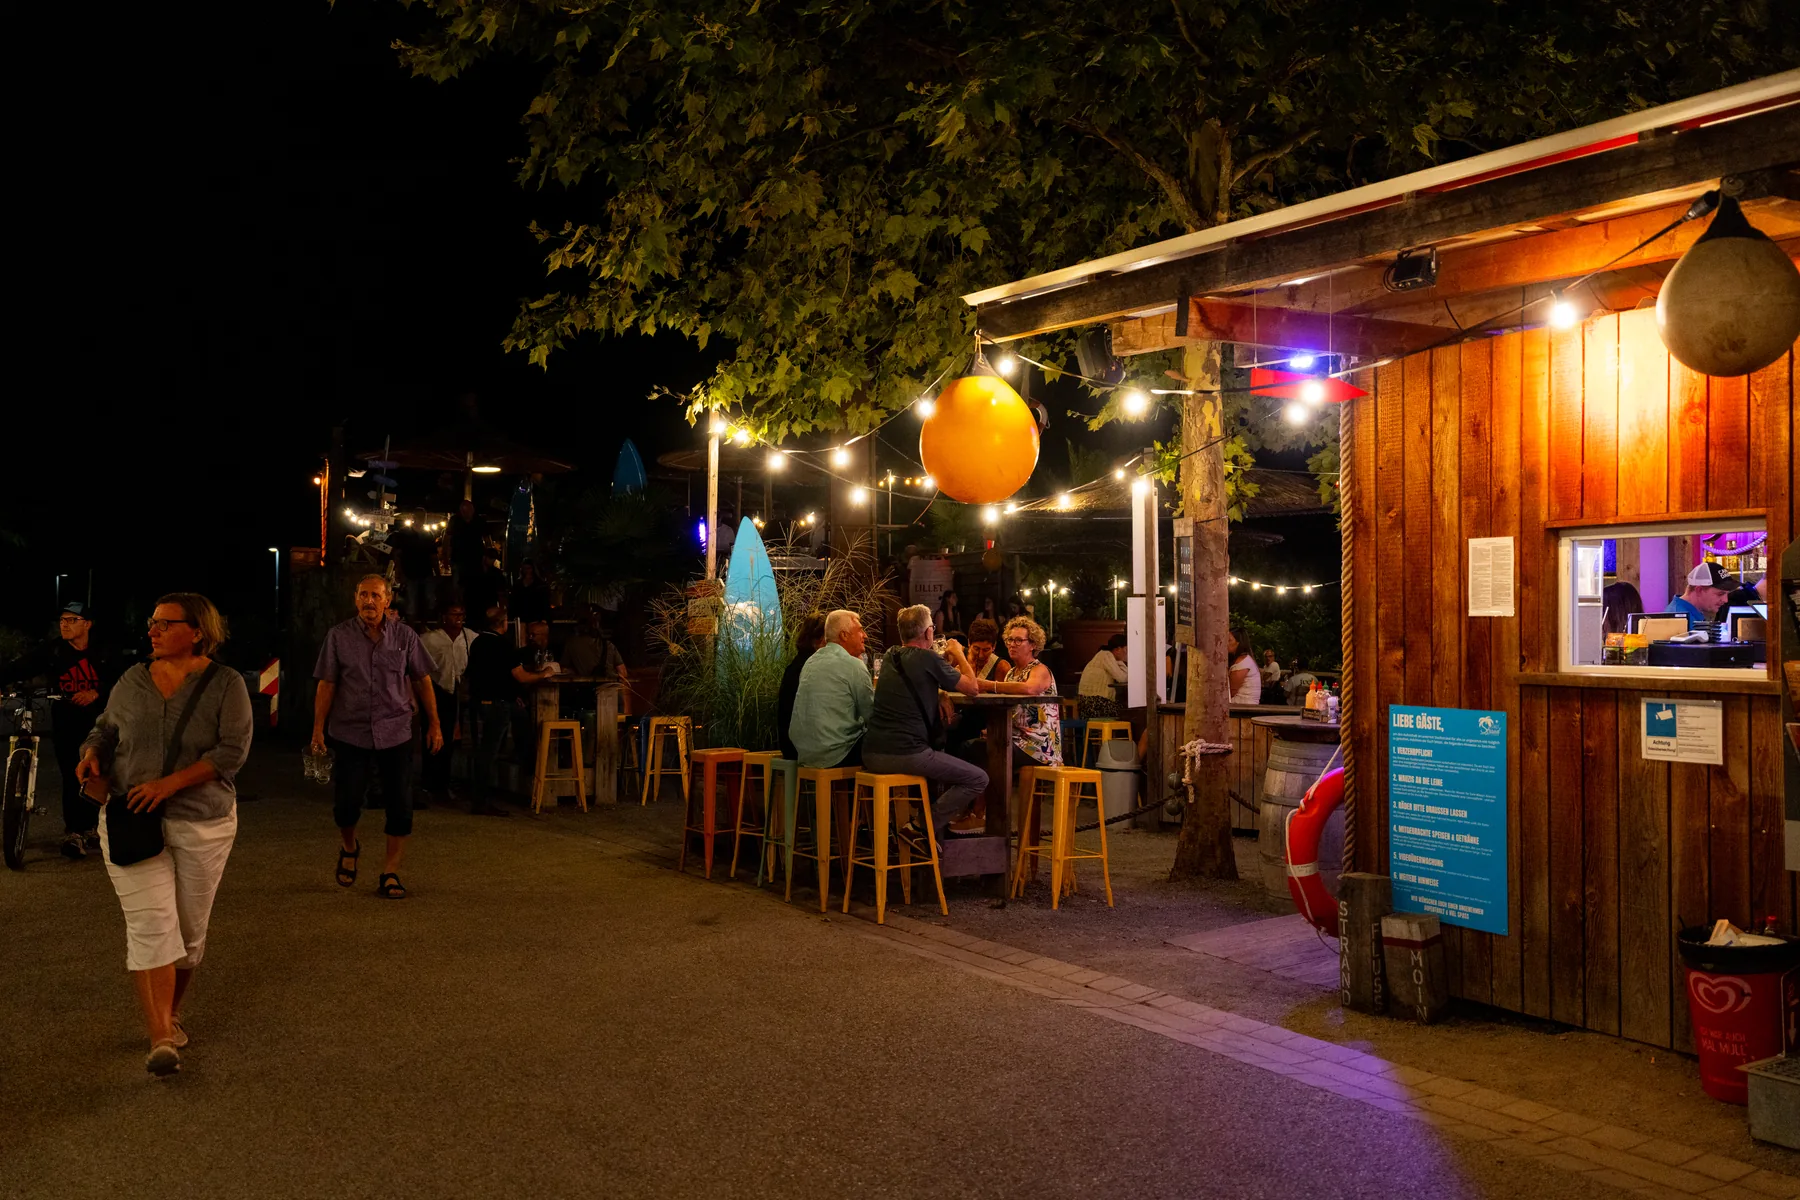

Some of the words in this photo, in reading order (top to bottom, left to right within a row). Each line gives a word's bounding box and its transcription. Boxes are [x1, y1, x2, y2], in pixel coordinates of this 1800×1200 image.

[915, 584, 943, 592] LILLET
[1393, 714, 1414, 728] LIEBE
[1417, 713, 1444, 732] GÄSTE,
[1431, 778, 1443, 786] LEINE
[1399, 801, 1412, 810] RÄDER
[1426, 806, 1448, 815] DRAUSSEN
[1450, 809, 1467, 818] LASSEN
[1432, 830, 1450, 840] SPEISEN
[1340, 901, 1351, 1005] STRAND
[1410, 950, 1428, 1023] MOIN
